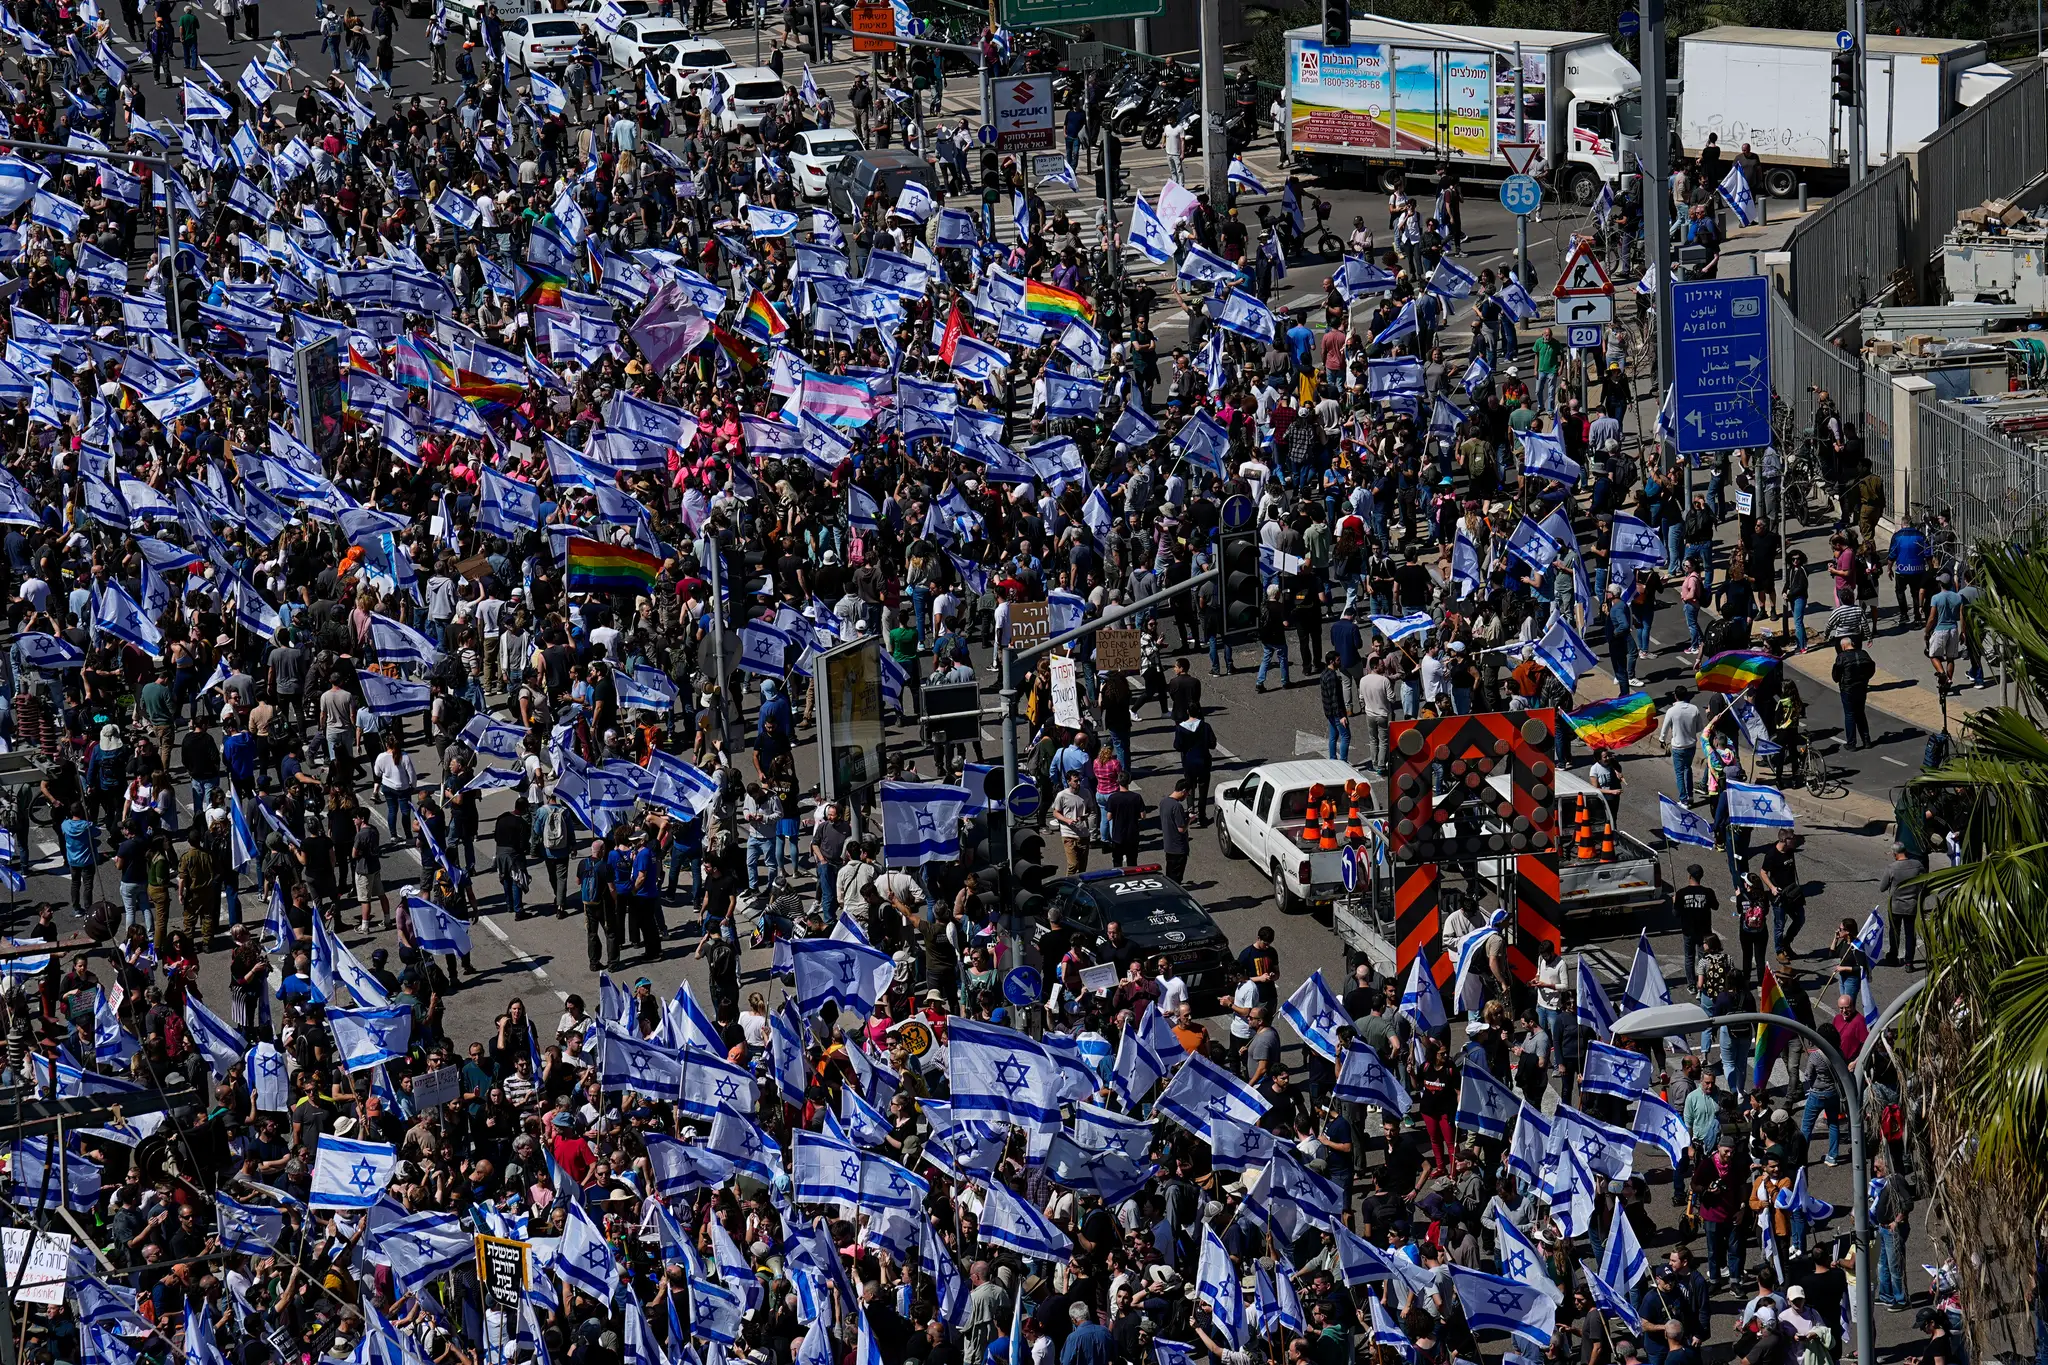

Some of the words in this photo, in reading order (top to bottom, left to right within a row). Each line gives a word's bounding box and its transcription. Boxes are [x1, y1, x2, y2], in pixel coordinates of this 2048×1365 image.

[1322, 52, 1353, 65] הובלות
[1356, 56, 1380, 68] אפיק
[1450, 66, 1486, 79] מומלצים
[1322, 78, 1380, 89] 1800-38-38-68
[1000, 106, 1047, 118] SUZUKI
[1458, 107, 1480, 118] גופים
[1004, 133, 1026, 142] סוזוקי
[1454, 126, 1484, 138] רשמיים
[1507, 183, 1534, 205] 55
[1685, 290, 1722, 303] איילון
[1739, 303, 1753, 312] 20
[1683, 320, 1726, 333] Ayalon
[1576, 330, 1593, 341] 20
[1702, 344, 1729, 357] צפון
[1702, 361, 1730, 374] شمال
[1698, 375, 1734, 386] North
[1714, 400, 1743, 411] דרום
[1715, 417, 1743, 428] جنوب
[1711, 430, 1748, 441] South
[1120, 631, 1139, 639] WANT
[1096, 641, 1108, 649] TO
[1130, 640, 1139, 649] UP
[1106, 649, 1130, 658] LIKE
[1100, 657, 1139, 669] TURKEY
[1110, 878, 1163, 895] 255
[902, 1028, 920, 1043] לא
[486, 1242, 520, 1261] ממשלת
[492, 1258, 515, 1275] חורבן
[496, 1273, 512, 1288] בית
[492, 1286, 518, 1303] שלישי
